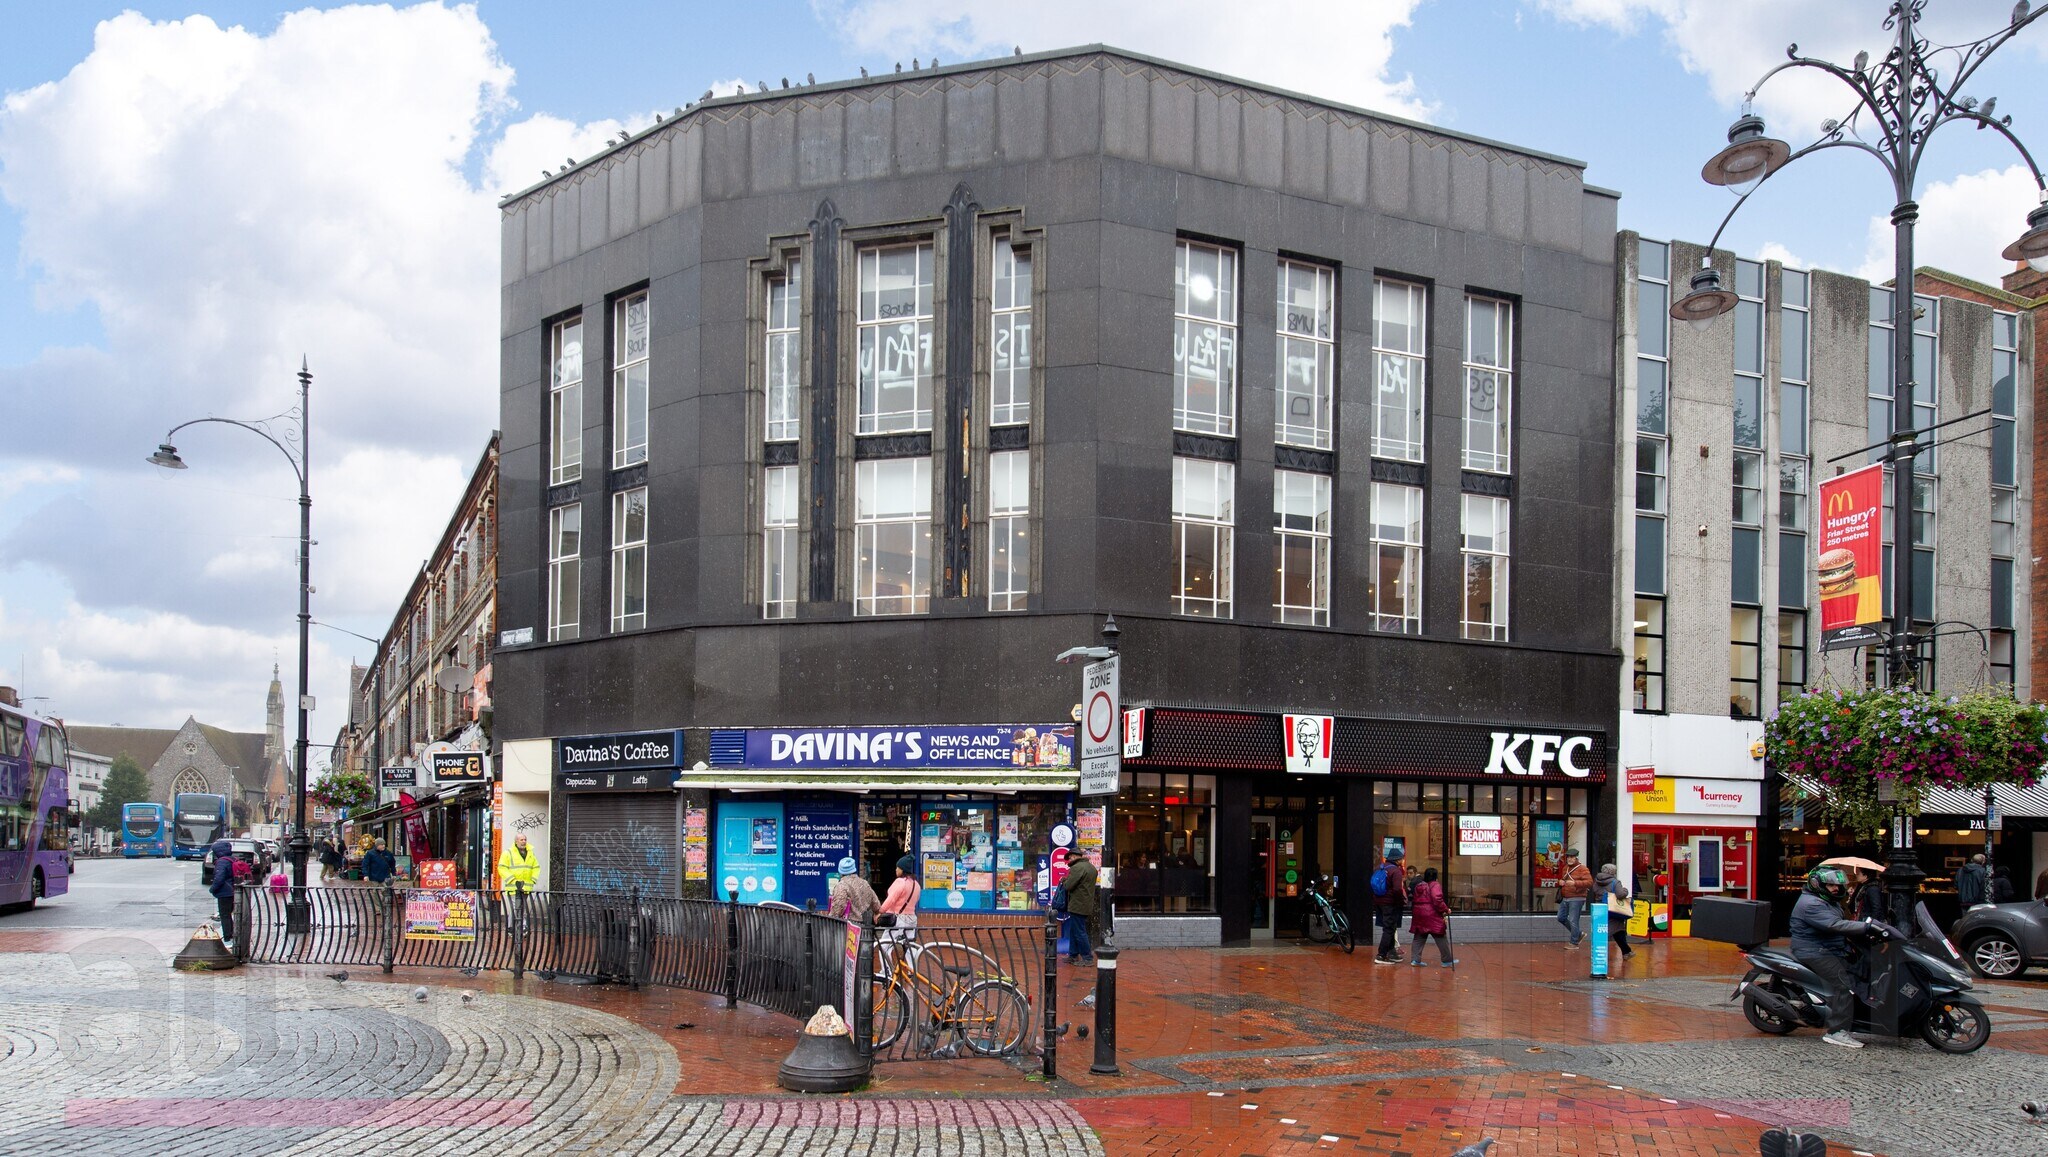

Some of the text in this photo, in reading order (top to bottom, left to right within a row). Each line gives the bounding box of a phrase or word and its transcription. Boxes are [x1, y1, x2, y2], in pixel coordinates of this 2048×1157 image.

[1827, 506, 1877, 529] Hungry?
[1827, 523, 1869, 539] Friar Street
[1827, 530, 1869, 547] 250 metres
[1086, 661, 1115, 675] PEDESTRIAN
[1089, 672, 1111, 690] ZONE
[930, 735, 1000, 746] NEWS AND
[624, 742, 669, 760] Coffee
[771, 731, 923, 763] DAVINA'S
[1085, 744, 1114, 756] No vehicles
[1127, 744, 1141, 755] KFC
[929, 748, 1010, 760] OFF LICENCE
[1484, 731, 1593, 777] KFC
[436, 758, 465, 767] PHONE
[1091, 760, 1109, 770] Except
[439, 767, 463, 776] CARE
[1082, 769, 1117, 780] Disabled Badge
[1628, 772, 1653, 780] Currency
[565, 775, 648, 787] Cappuccino Latte
[1090, 781, 1108, 790] holders
[1628, 778, 1654, 787] Exchange
[922, 812, 948, 820] OPEN
[1461, 820, 1481, 829] HELLO
[1970, 820, 1986, 829] PAU
[1461, 829, 1499, 842] READING
[928, 864, 950, 872] 10 UK
[1541, 879, 1558, 888] KFC
[408, 902, 444, 911] FIREWORKS
[445, 918, 473, 927] OCTOBER
